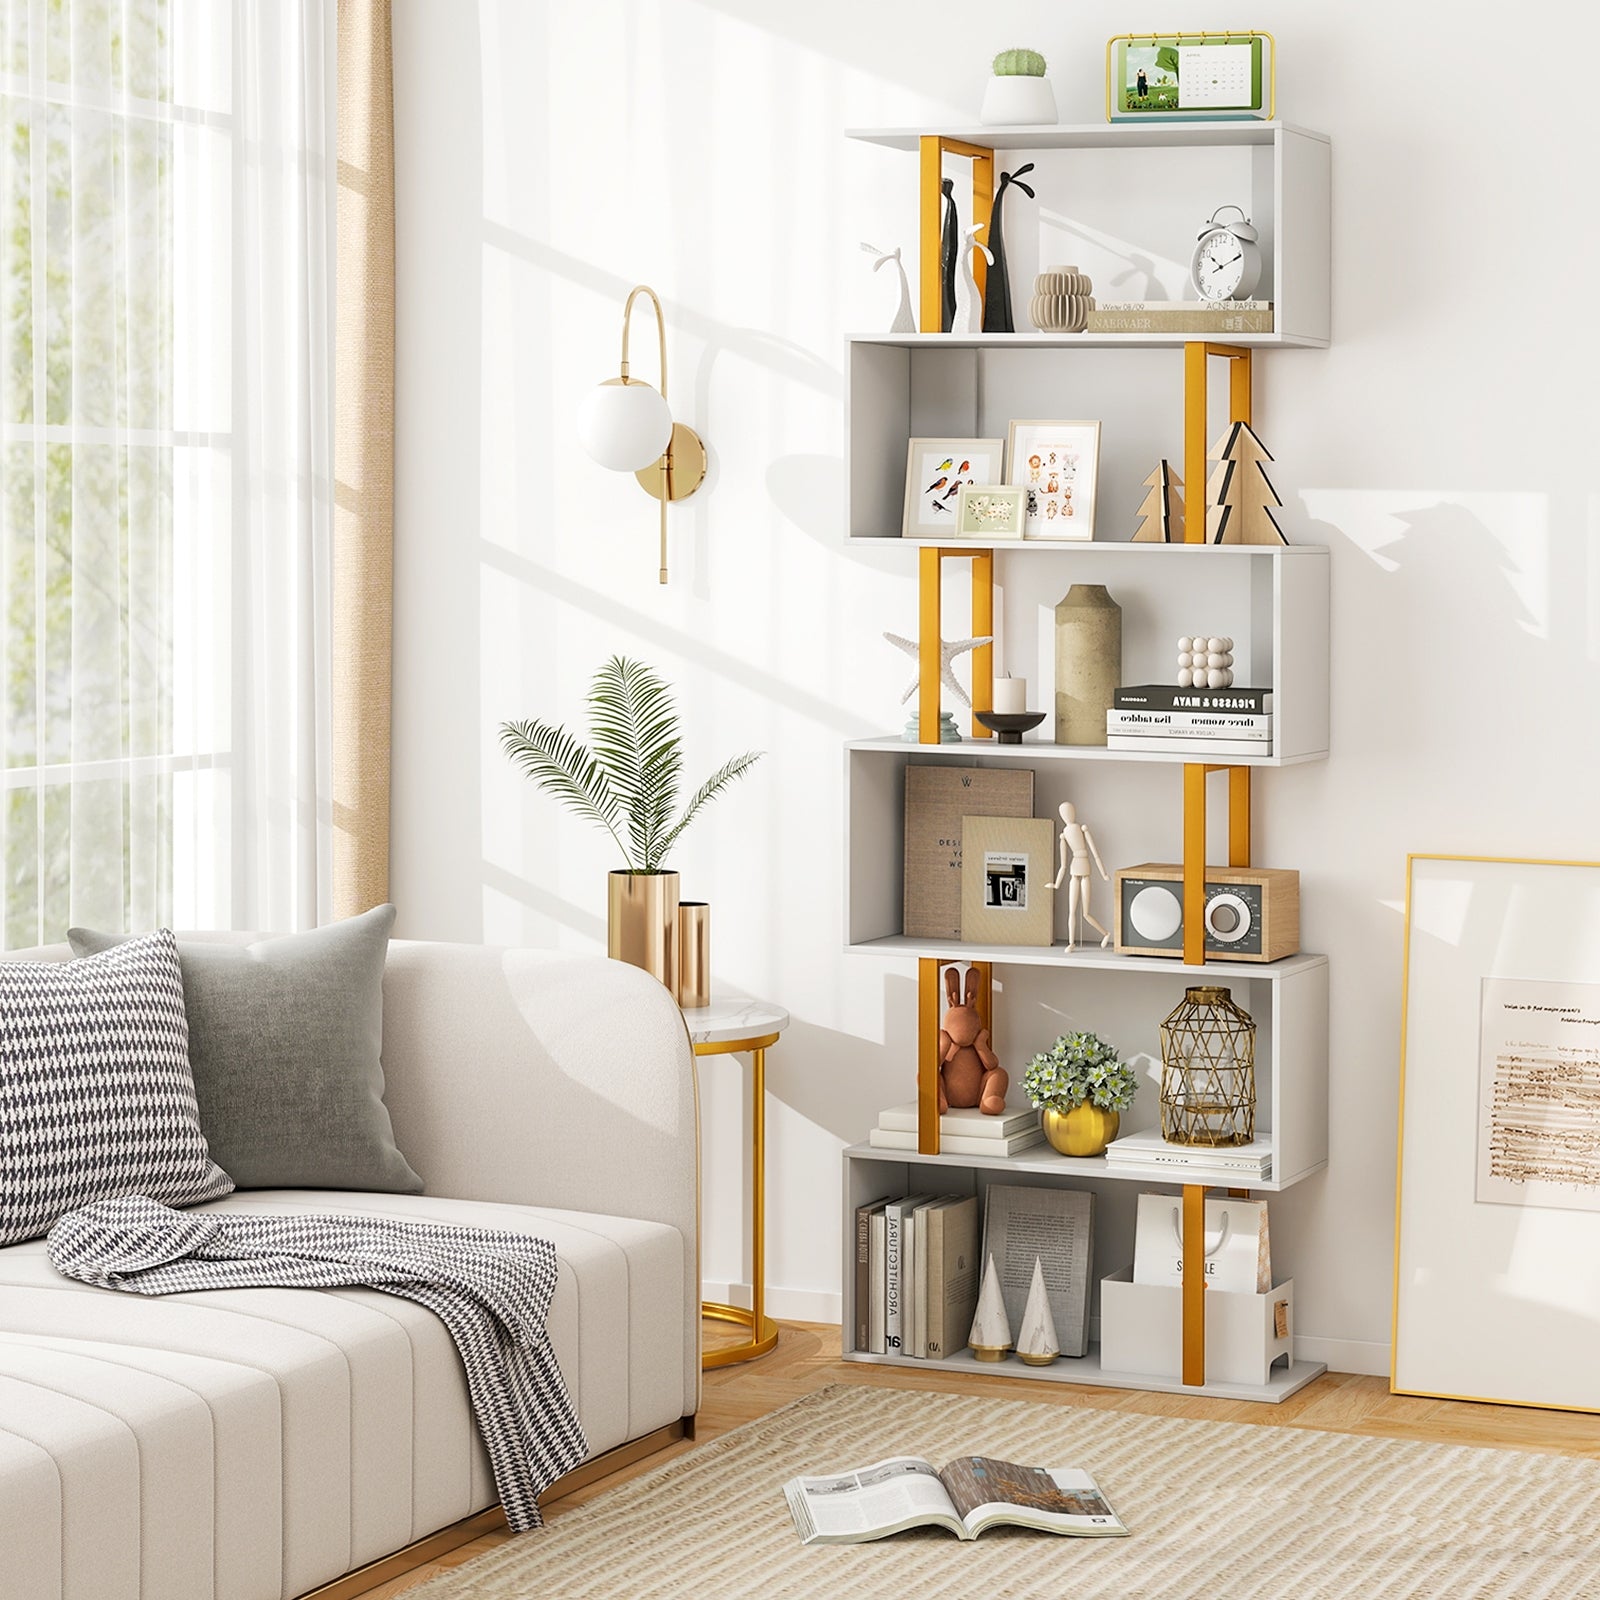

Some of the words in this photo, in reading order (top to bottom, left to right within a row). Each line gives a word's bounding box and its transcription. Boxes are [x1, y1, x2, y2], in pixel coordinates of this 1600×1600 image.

[1210, 239, 1218, 248] 11
[1219, 234, 1228, 244] 12
[1202, 248, 1211, 258] 10
[1199, 276, 1205, 285] 8
[1207, 285, 1212, 294] 7
[1217, 289, 1222, 299] 6
[1234, 302, 1258, 311] PAPER
[1177, 1260, 1215, 1275] SLE
